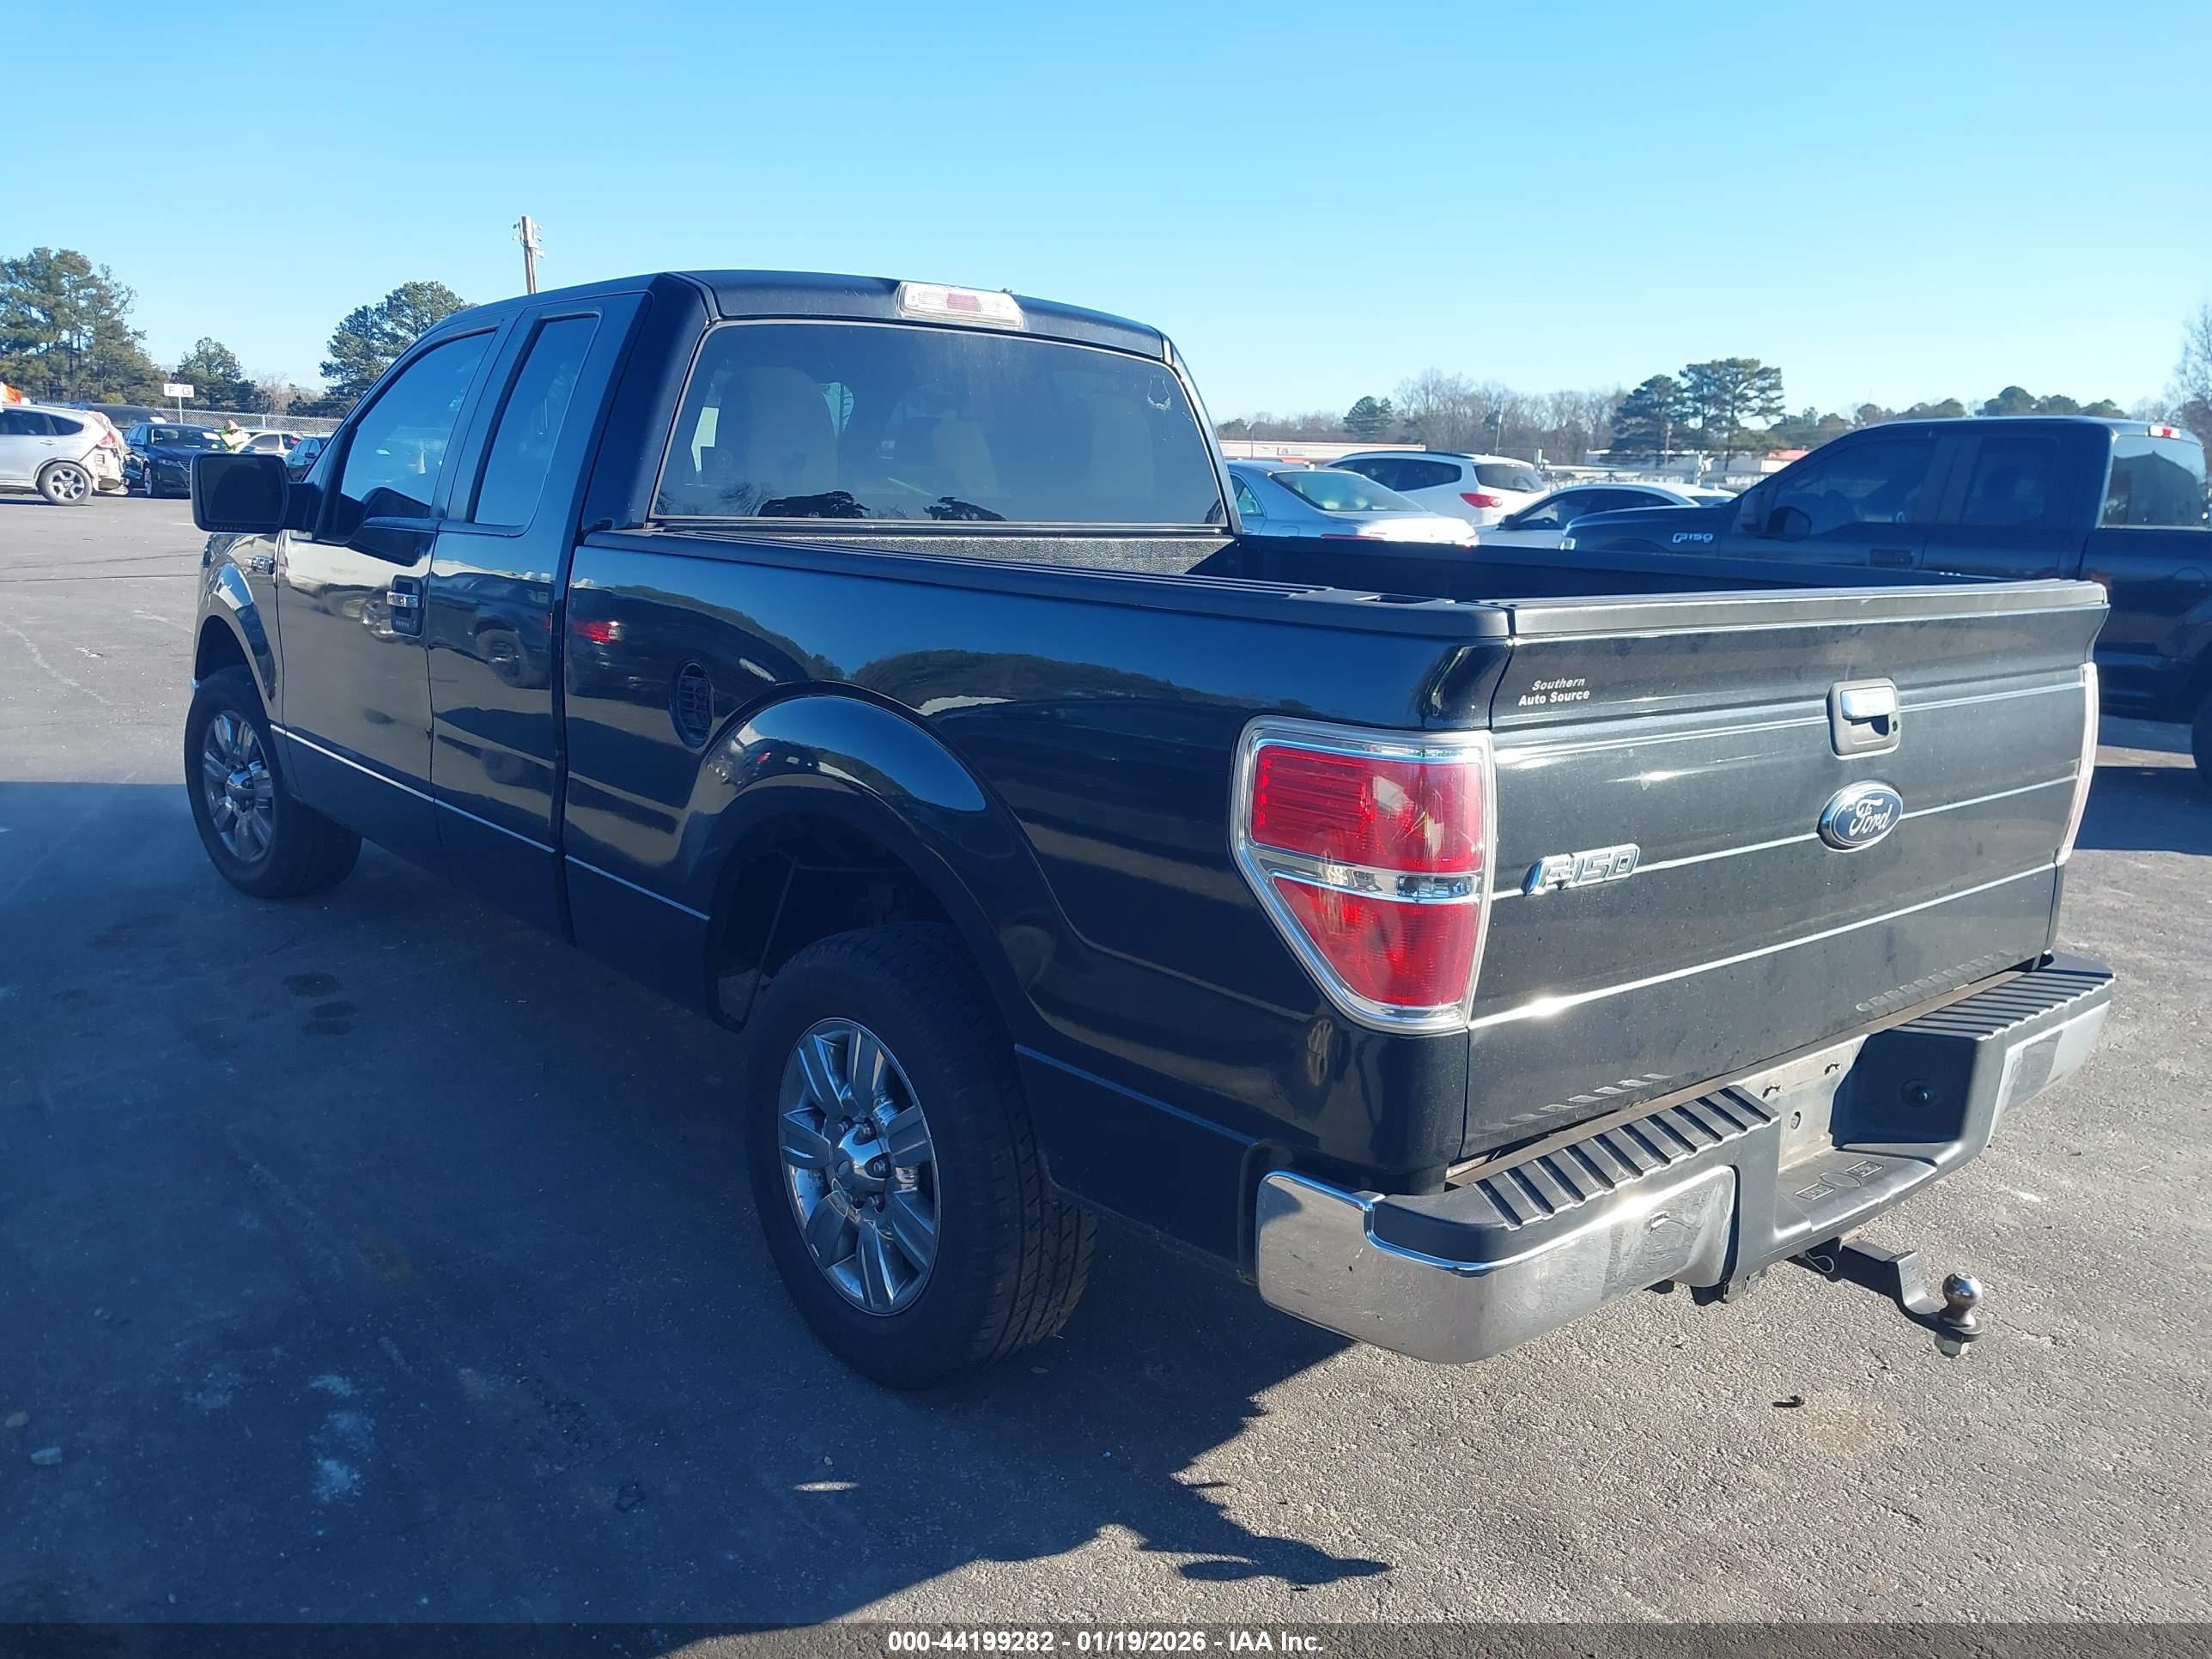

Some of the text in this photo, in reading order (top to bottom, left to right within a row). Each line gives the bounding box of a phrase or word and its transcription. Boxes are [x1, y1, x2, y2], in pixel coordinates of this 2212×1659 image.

[181, 386, 191, 396] G
[1532, 678, 1586, 691] Southern
[1518, 690, 1590, 707] Auto Source
[1849, 797, 1893, 836] Ford
